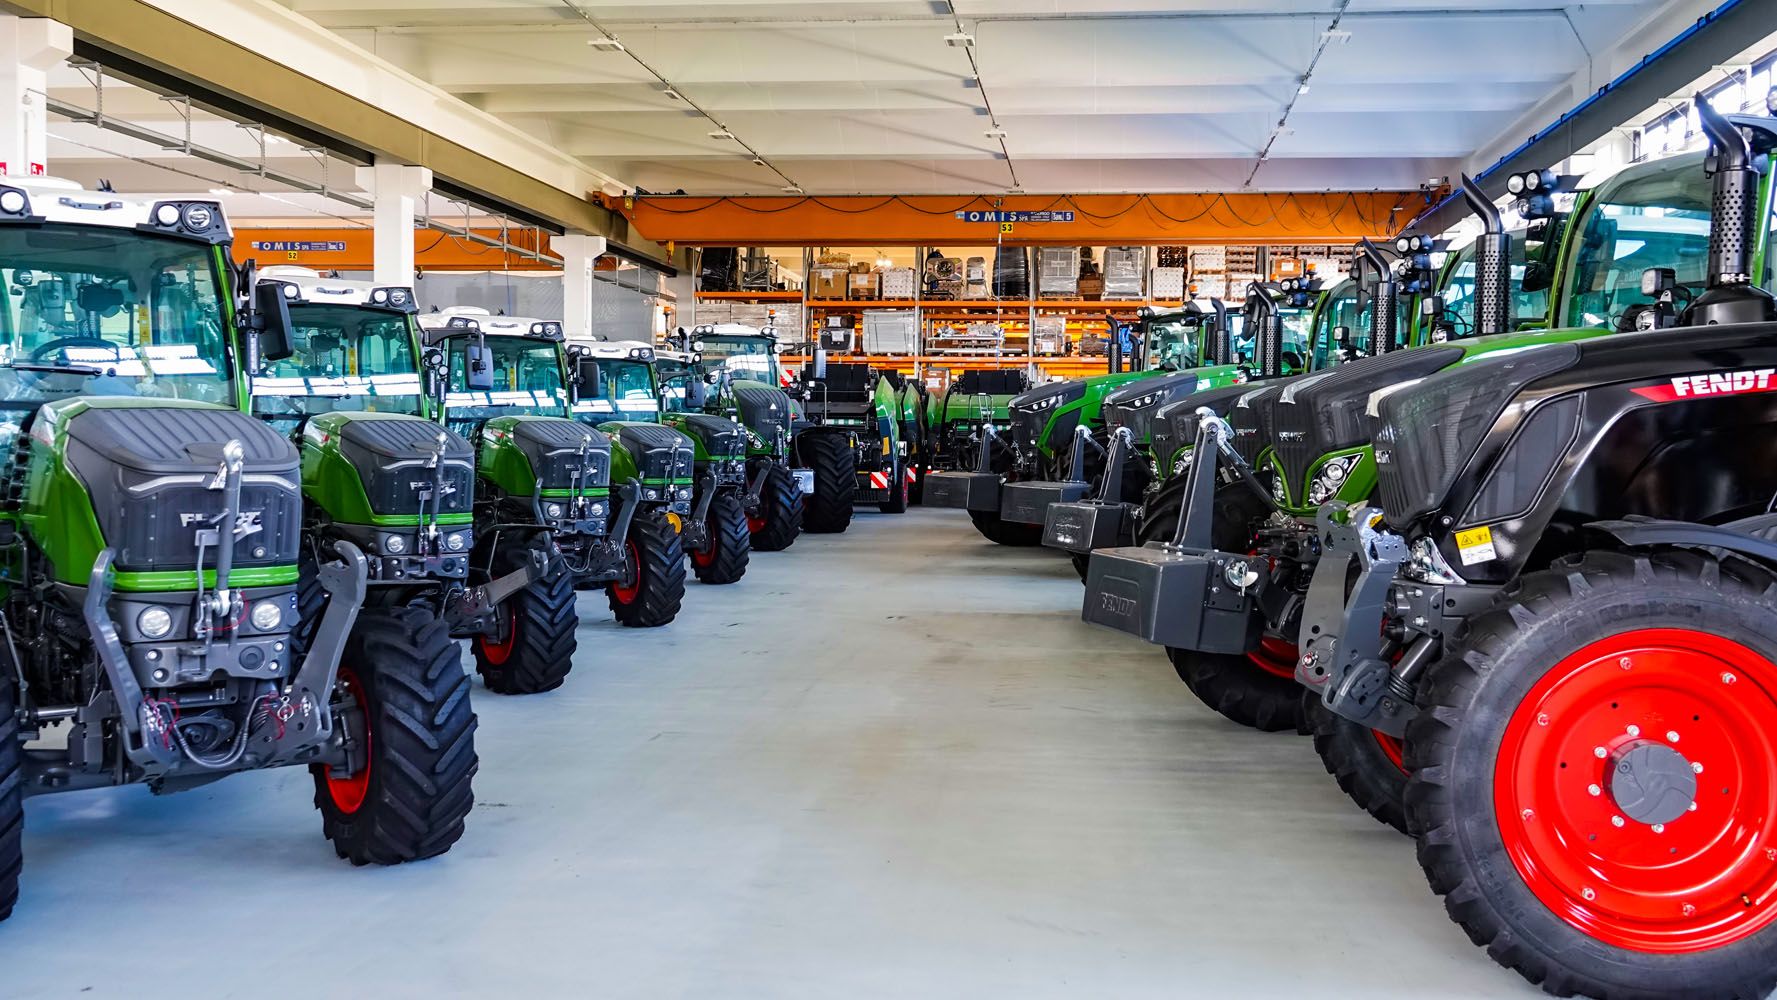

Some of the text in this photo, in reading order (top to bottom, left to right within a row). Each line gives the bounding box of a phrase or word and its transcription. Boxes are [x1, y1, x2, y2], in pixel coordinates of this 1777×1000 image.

[969, 211, 1017, 222] OMIS
[263, 242, 300, 250] OMIS
[1671, 369, 1776, 397] FENDT
[1101, 592, 1136, 616] FENDT
